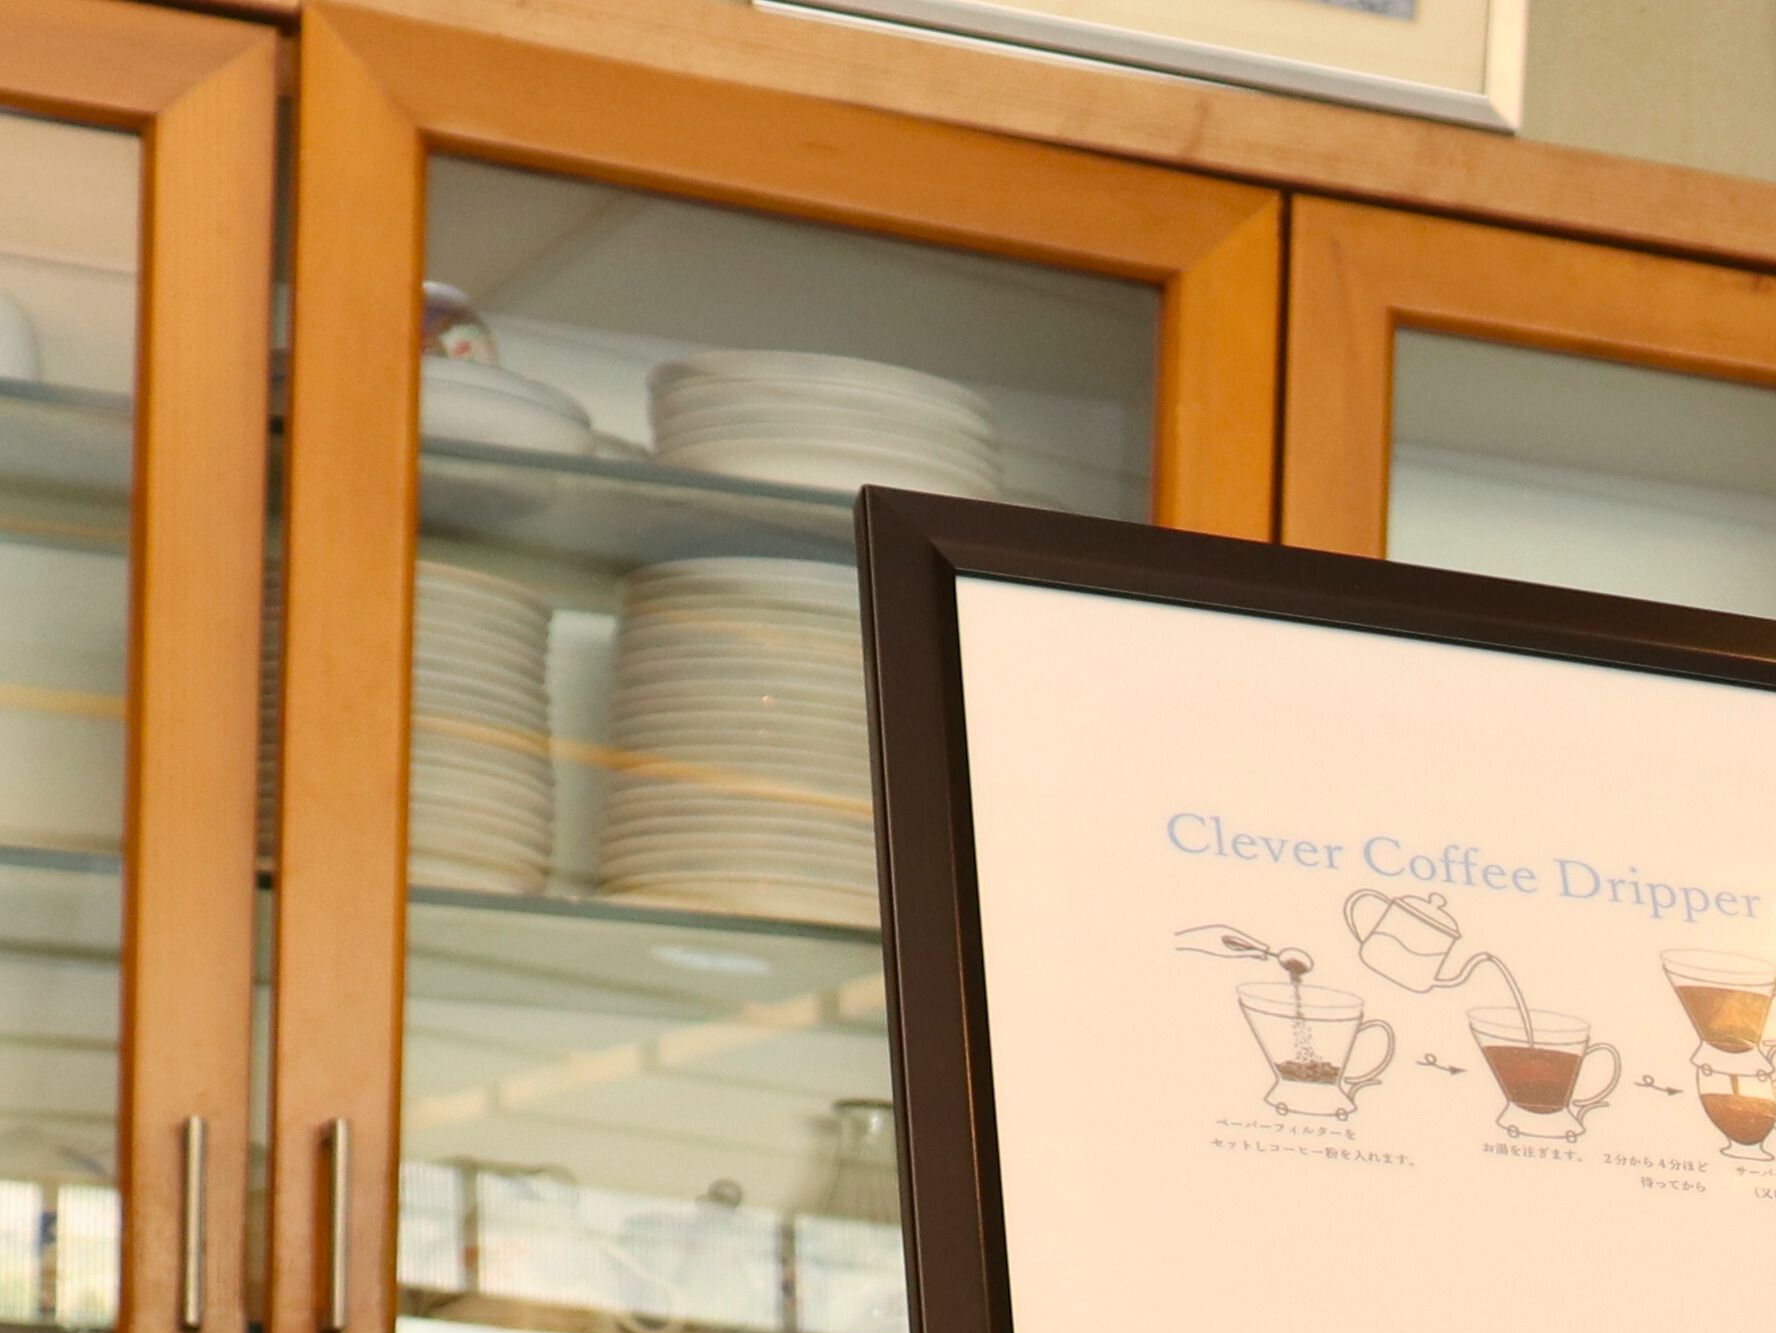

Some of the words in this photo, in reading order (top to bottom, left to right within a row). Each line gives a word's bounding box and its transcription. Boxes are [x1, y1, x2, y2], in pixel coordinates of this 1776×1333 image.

[1166, 811, 1345, 871] Clever
[1362, 835, 1539, 894] Coffee
[1552, 856, 1763, 923] Dripper
